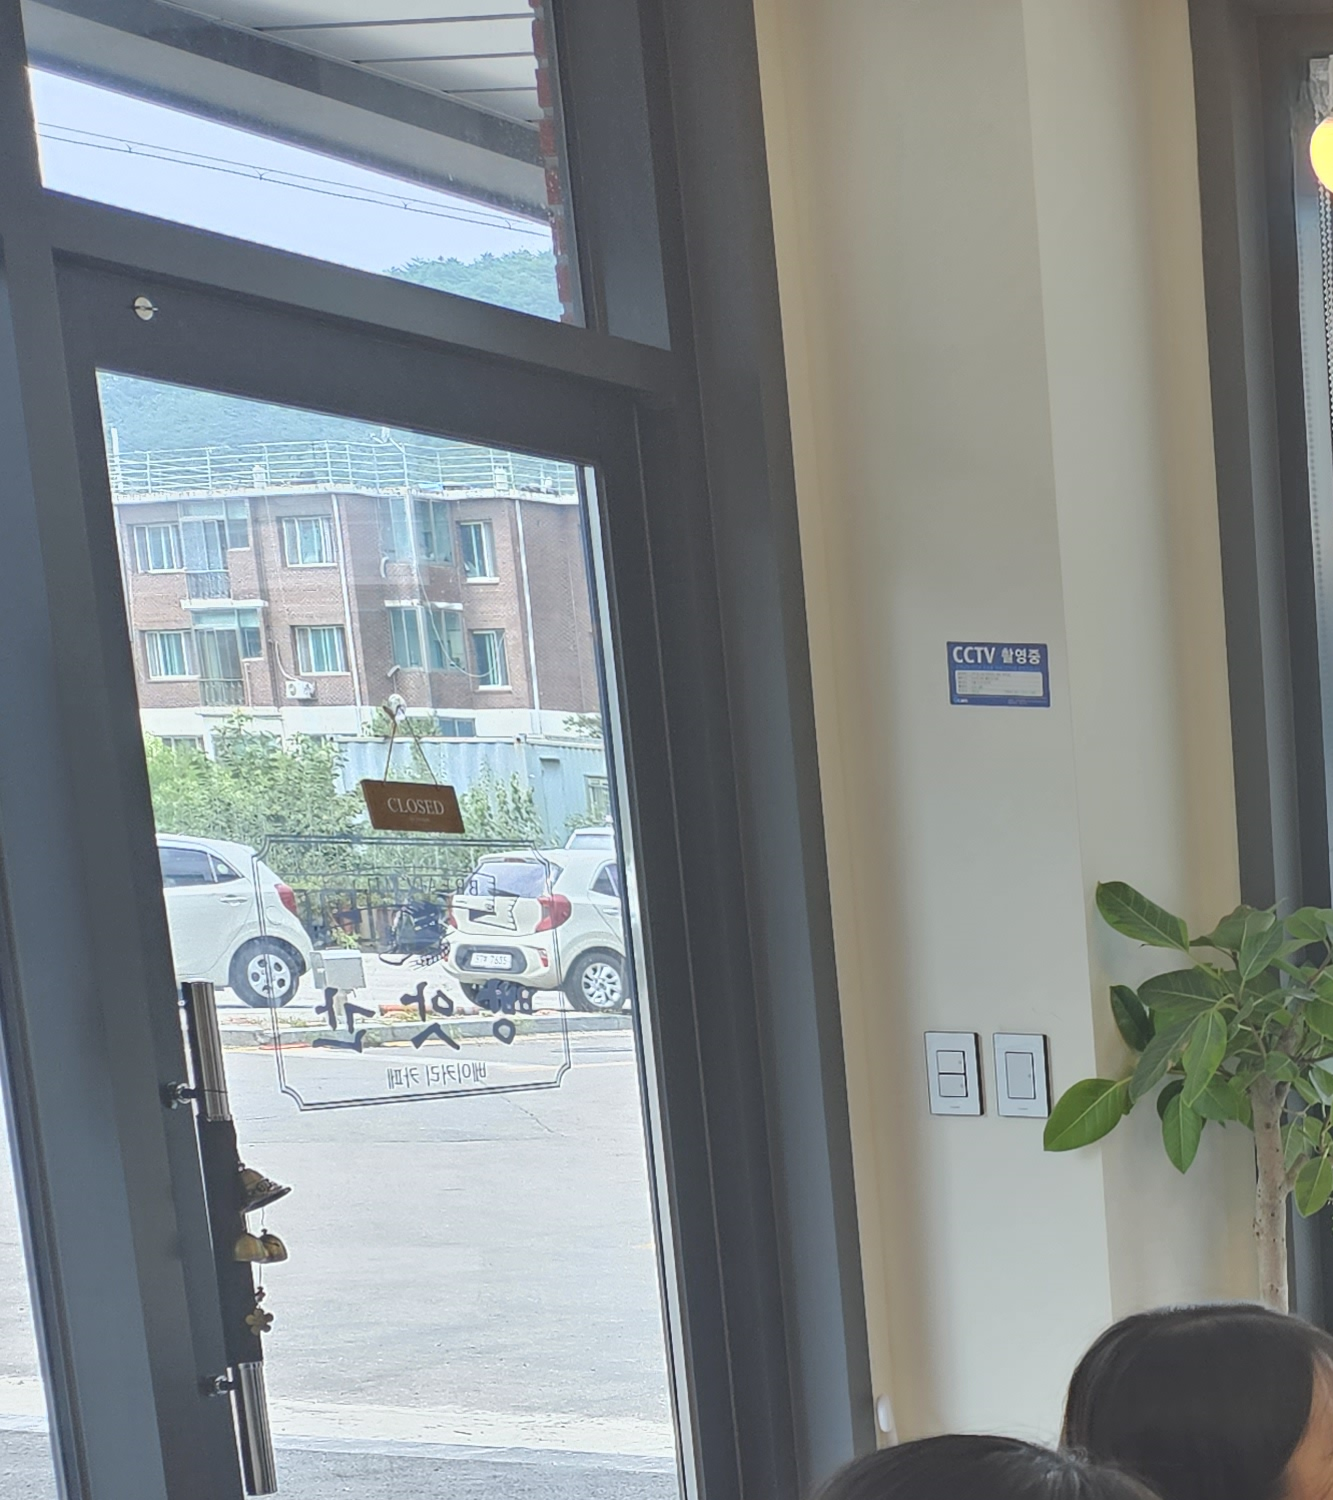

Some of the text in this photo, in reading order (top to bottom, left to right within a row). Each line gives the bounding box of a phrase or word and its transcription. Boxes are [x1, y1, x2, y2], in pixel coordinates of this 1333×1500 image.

[952, 646, 1041, 665] CCTV 촬영중
[387, 797, 445, 815] CLOSED
